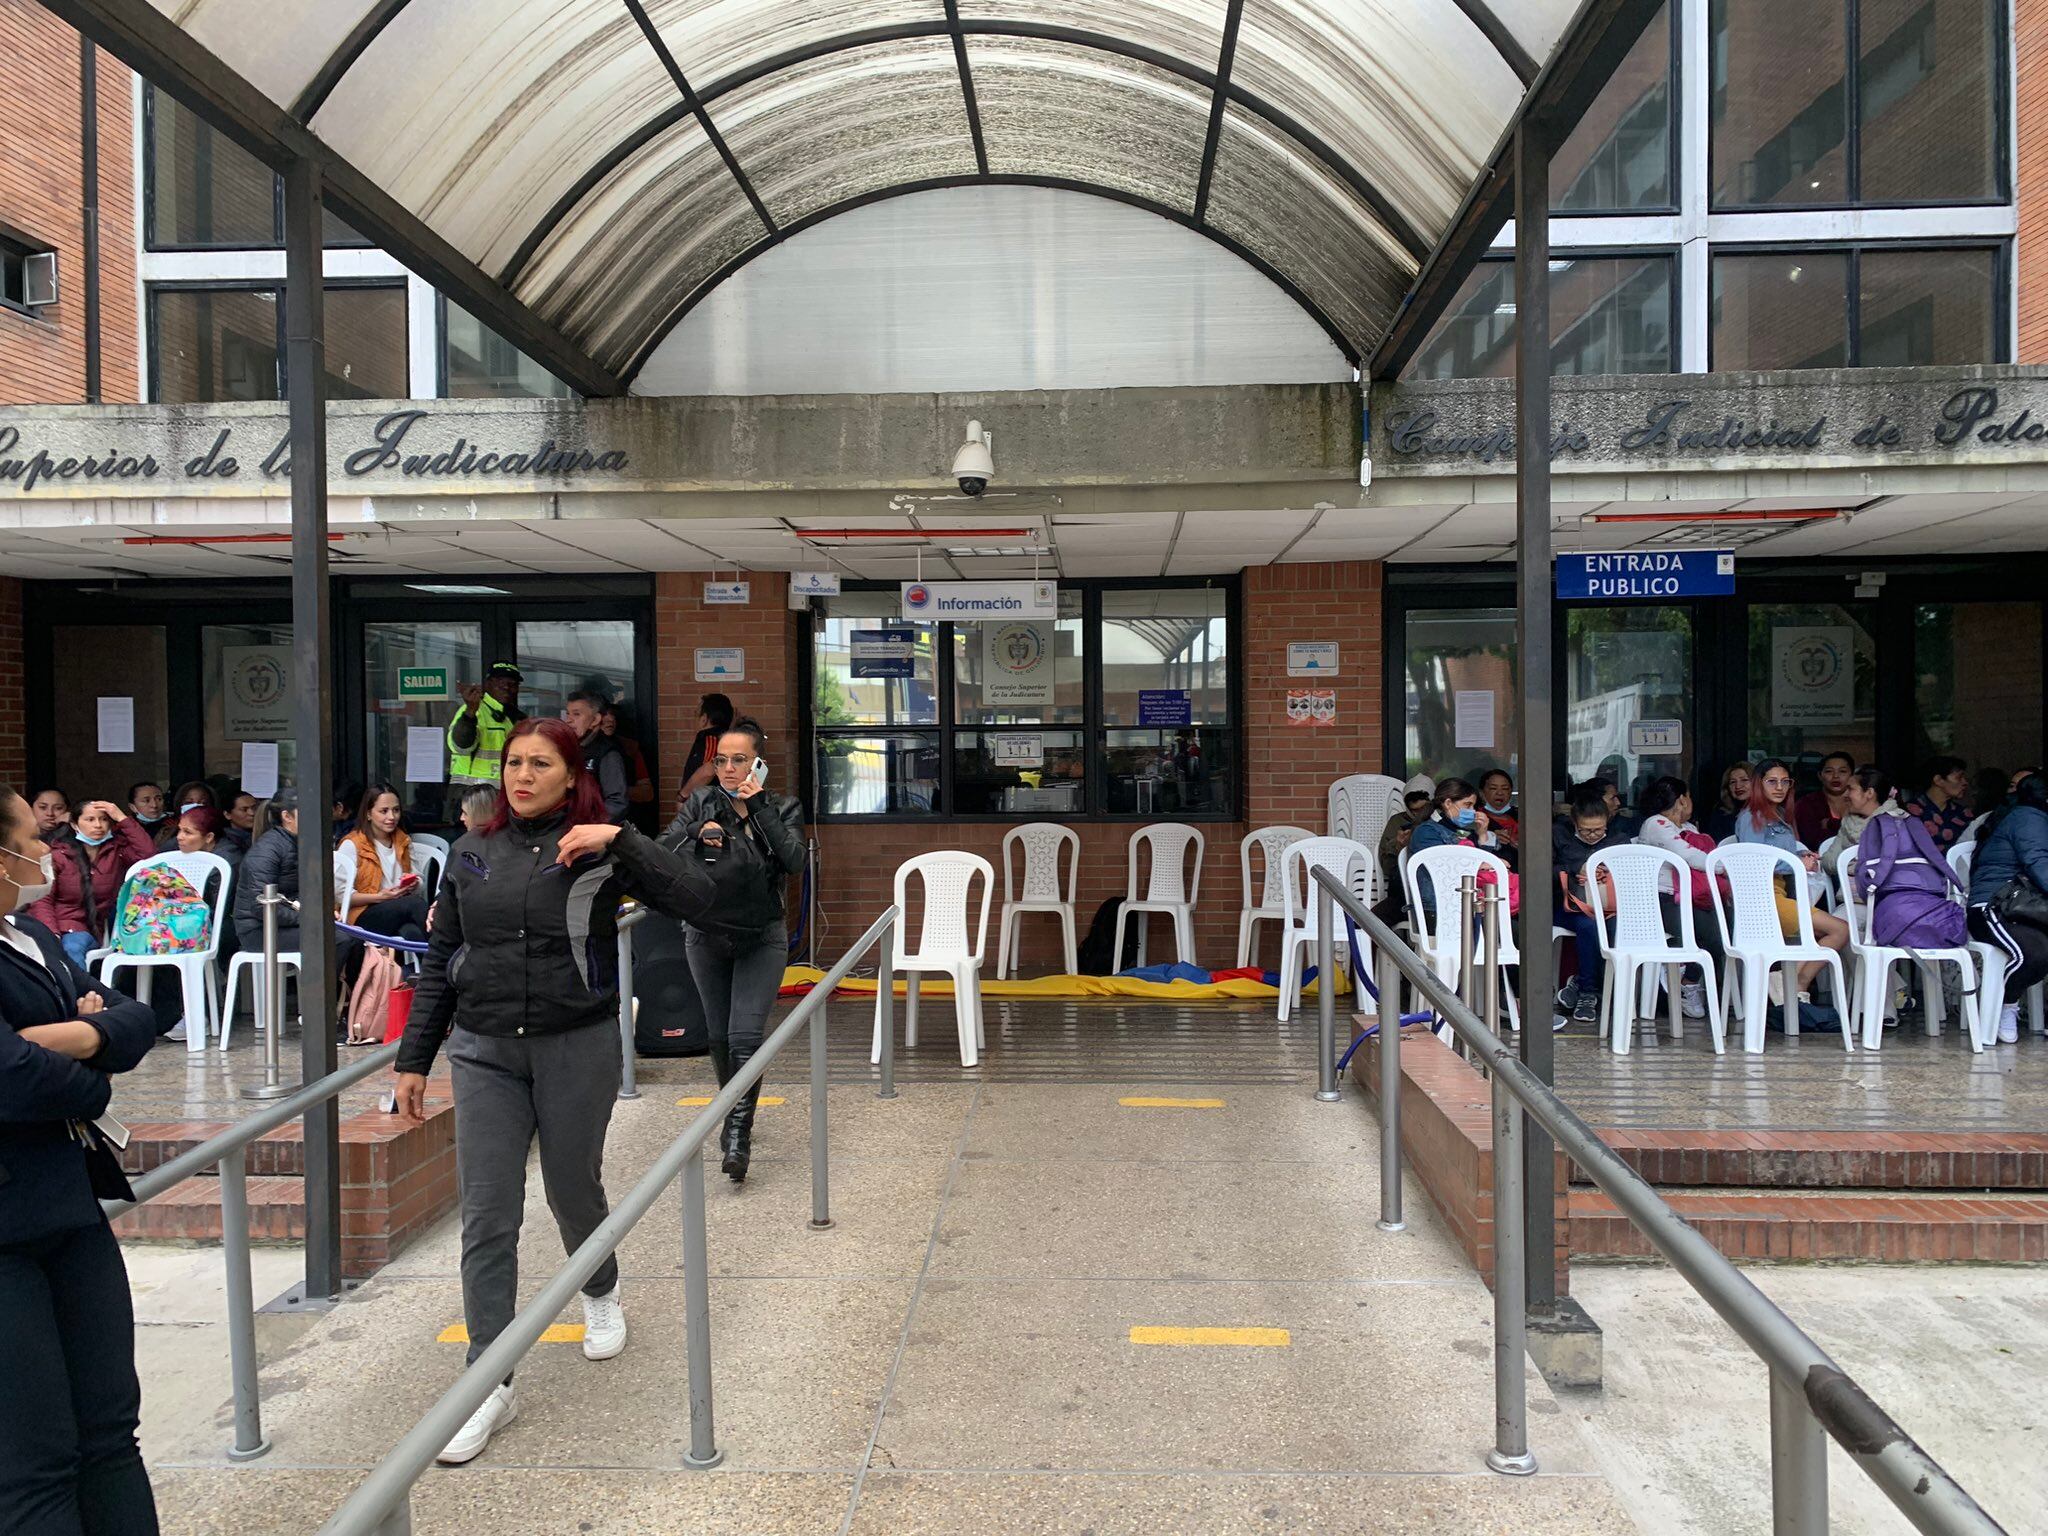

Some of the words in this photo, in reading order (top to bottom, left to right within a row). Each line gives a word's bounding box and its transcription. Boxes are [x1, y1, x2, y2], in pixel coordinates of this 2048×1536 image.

[1384, 410, 1590, 463] Compjo
[1620, 400, 1828, 450] Judicial
[1852, 414, 1902, 446] de
[184, 429, 240, 478] de
[344, 410, 630, 476] Judicatura
[1585, 554, 1684, 573] ENTRADA
[793, 585, 838, 594] Discapacitados
[1588, 577, 1680, 596] PUBLICO
[937, 597, 1022, 610] Información
[403, 676, 443, 688] SALIDA
[1017, 683, 1048, 692] Superior
